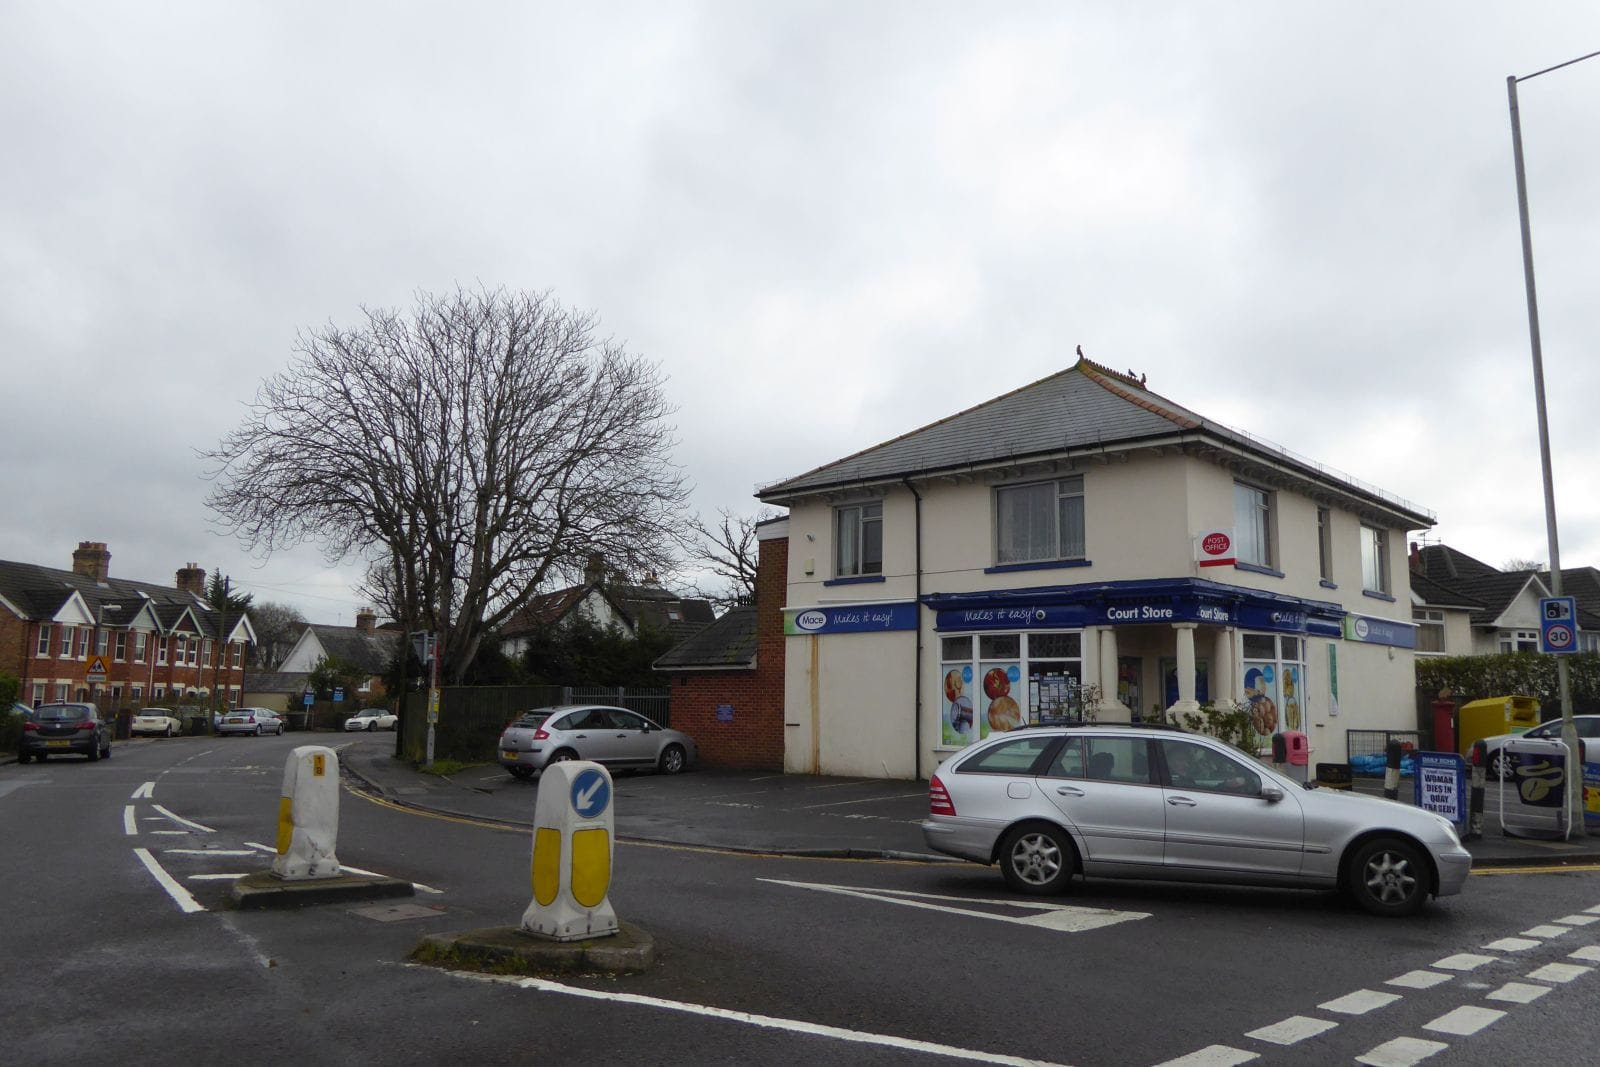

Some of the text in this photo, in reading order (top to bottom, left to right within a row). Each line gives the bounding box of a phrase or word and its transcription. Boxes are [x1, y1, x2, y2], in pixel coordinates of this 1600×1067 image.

[1205, 543, 1228, 551] OFFICE
[833, 613, 860, 625] Makes
[872, 608, 893, 626] easy!
[965, 610, 993, 622] Makes
[1008, 606, 1035, 624] easy!
[1107, 606, 1173, 619] Court Store
[1197, 607, 1229, 621] ourt Store
[802, 615, 824, 625] Mace
[1551, 631, 1568, 641] 30
[1424, 774, 1453, 784] WOMAN
[1426, 784, 1452, 794] DIES IN
[1431, 794, 1449, 803] QUAY
